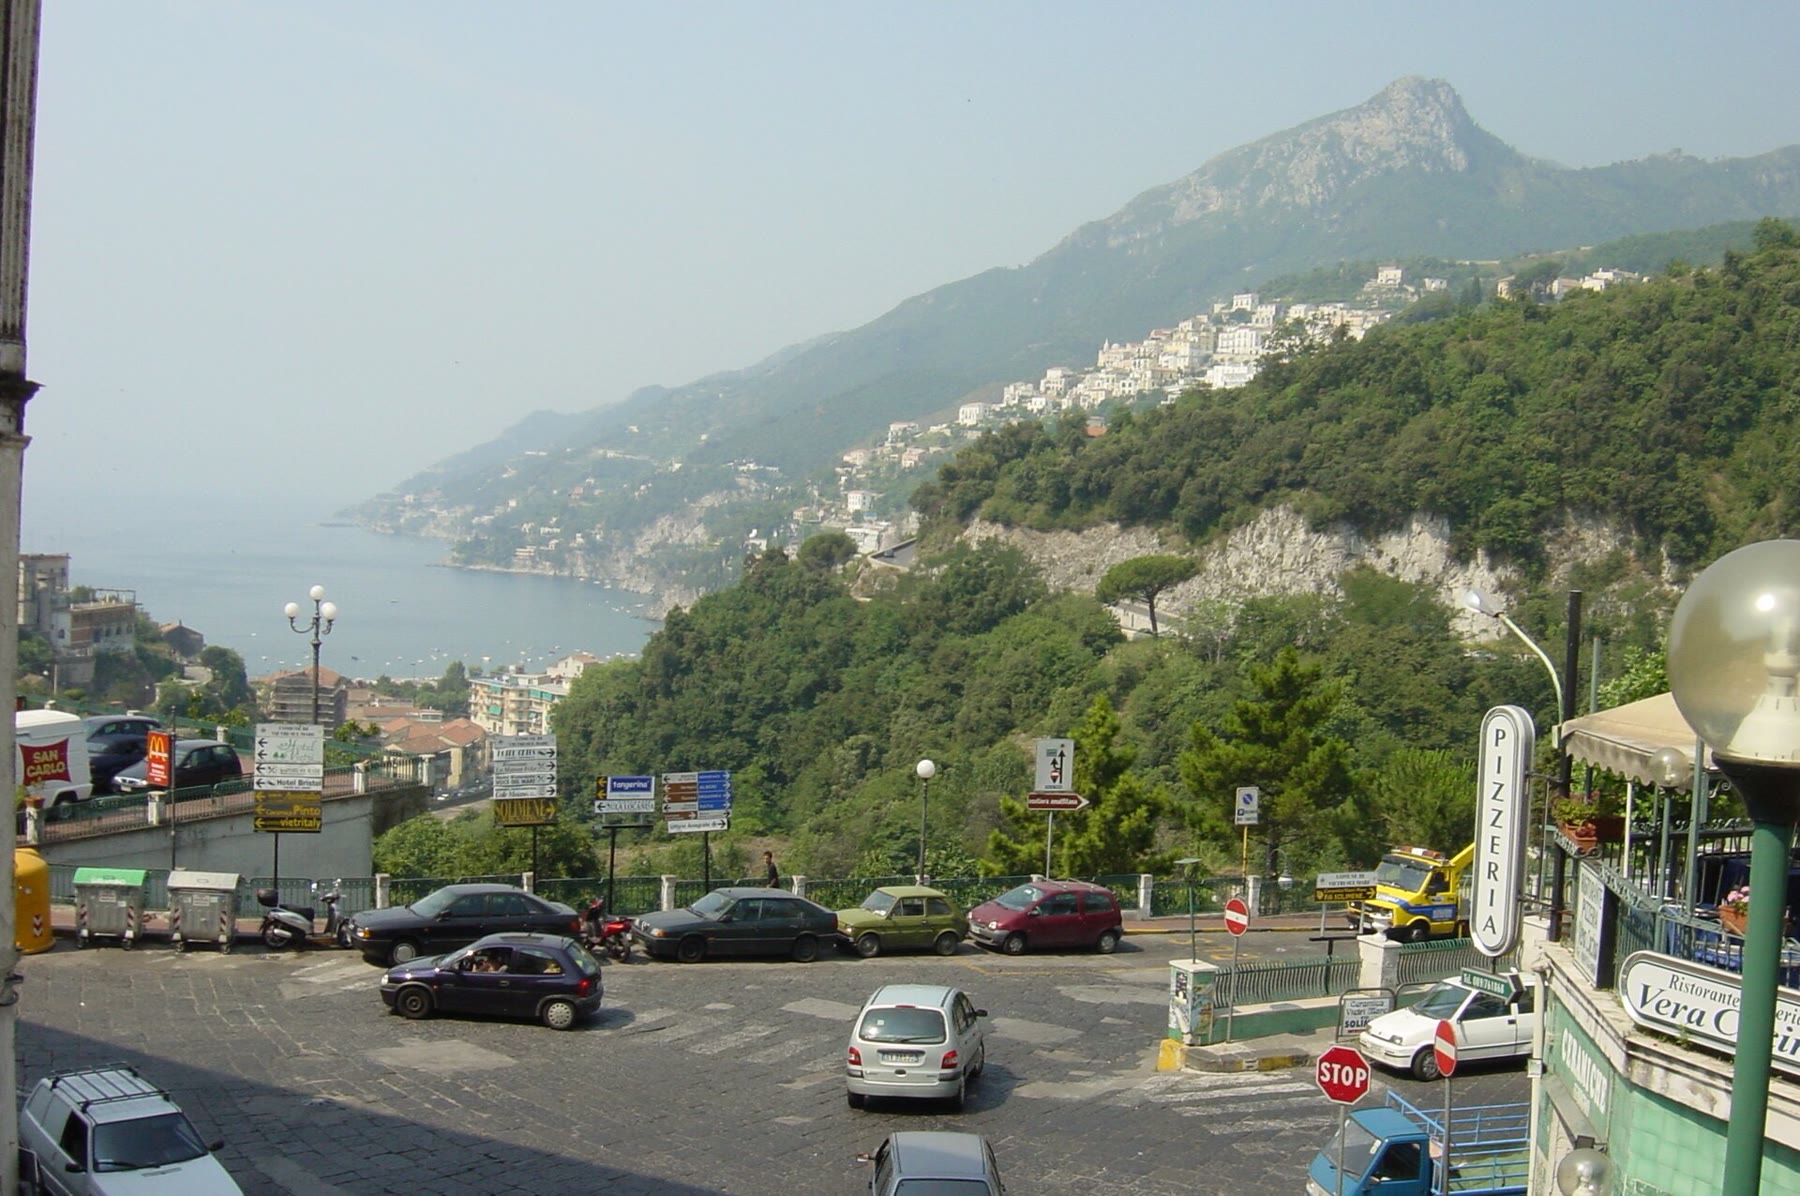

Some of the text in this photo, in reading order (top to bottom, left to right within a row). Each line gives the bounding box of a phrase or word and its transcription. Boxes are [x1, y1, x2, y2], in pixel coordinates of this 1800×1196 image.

[27, 761, 66, 778] CARLO
[33, 750, 59, 763] SAN
[280, 817, 321, 829] vietritaly
[293, 805, 321, 816] Pinto
[1482, 728, 1505, 935] PIZZERIA
[1669, 973, 1740, 1008] Ristorante
[1640, 983, 1706, 1028] Vera
[1320, 1062, 1368, 1088] STOP
[1562, 1028, 1608, 1115] CERAMICHE
